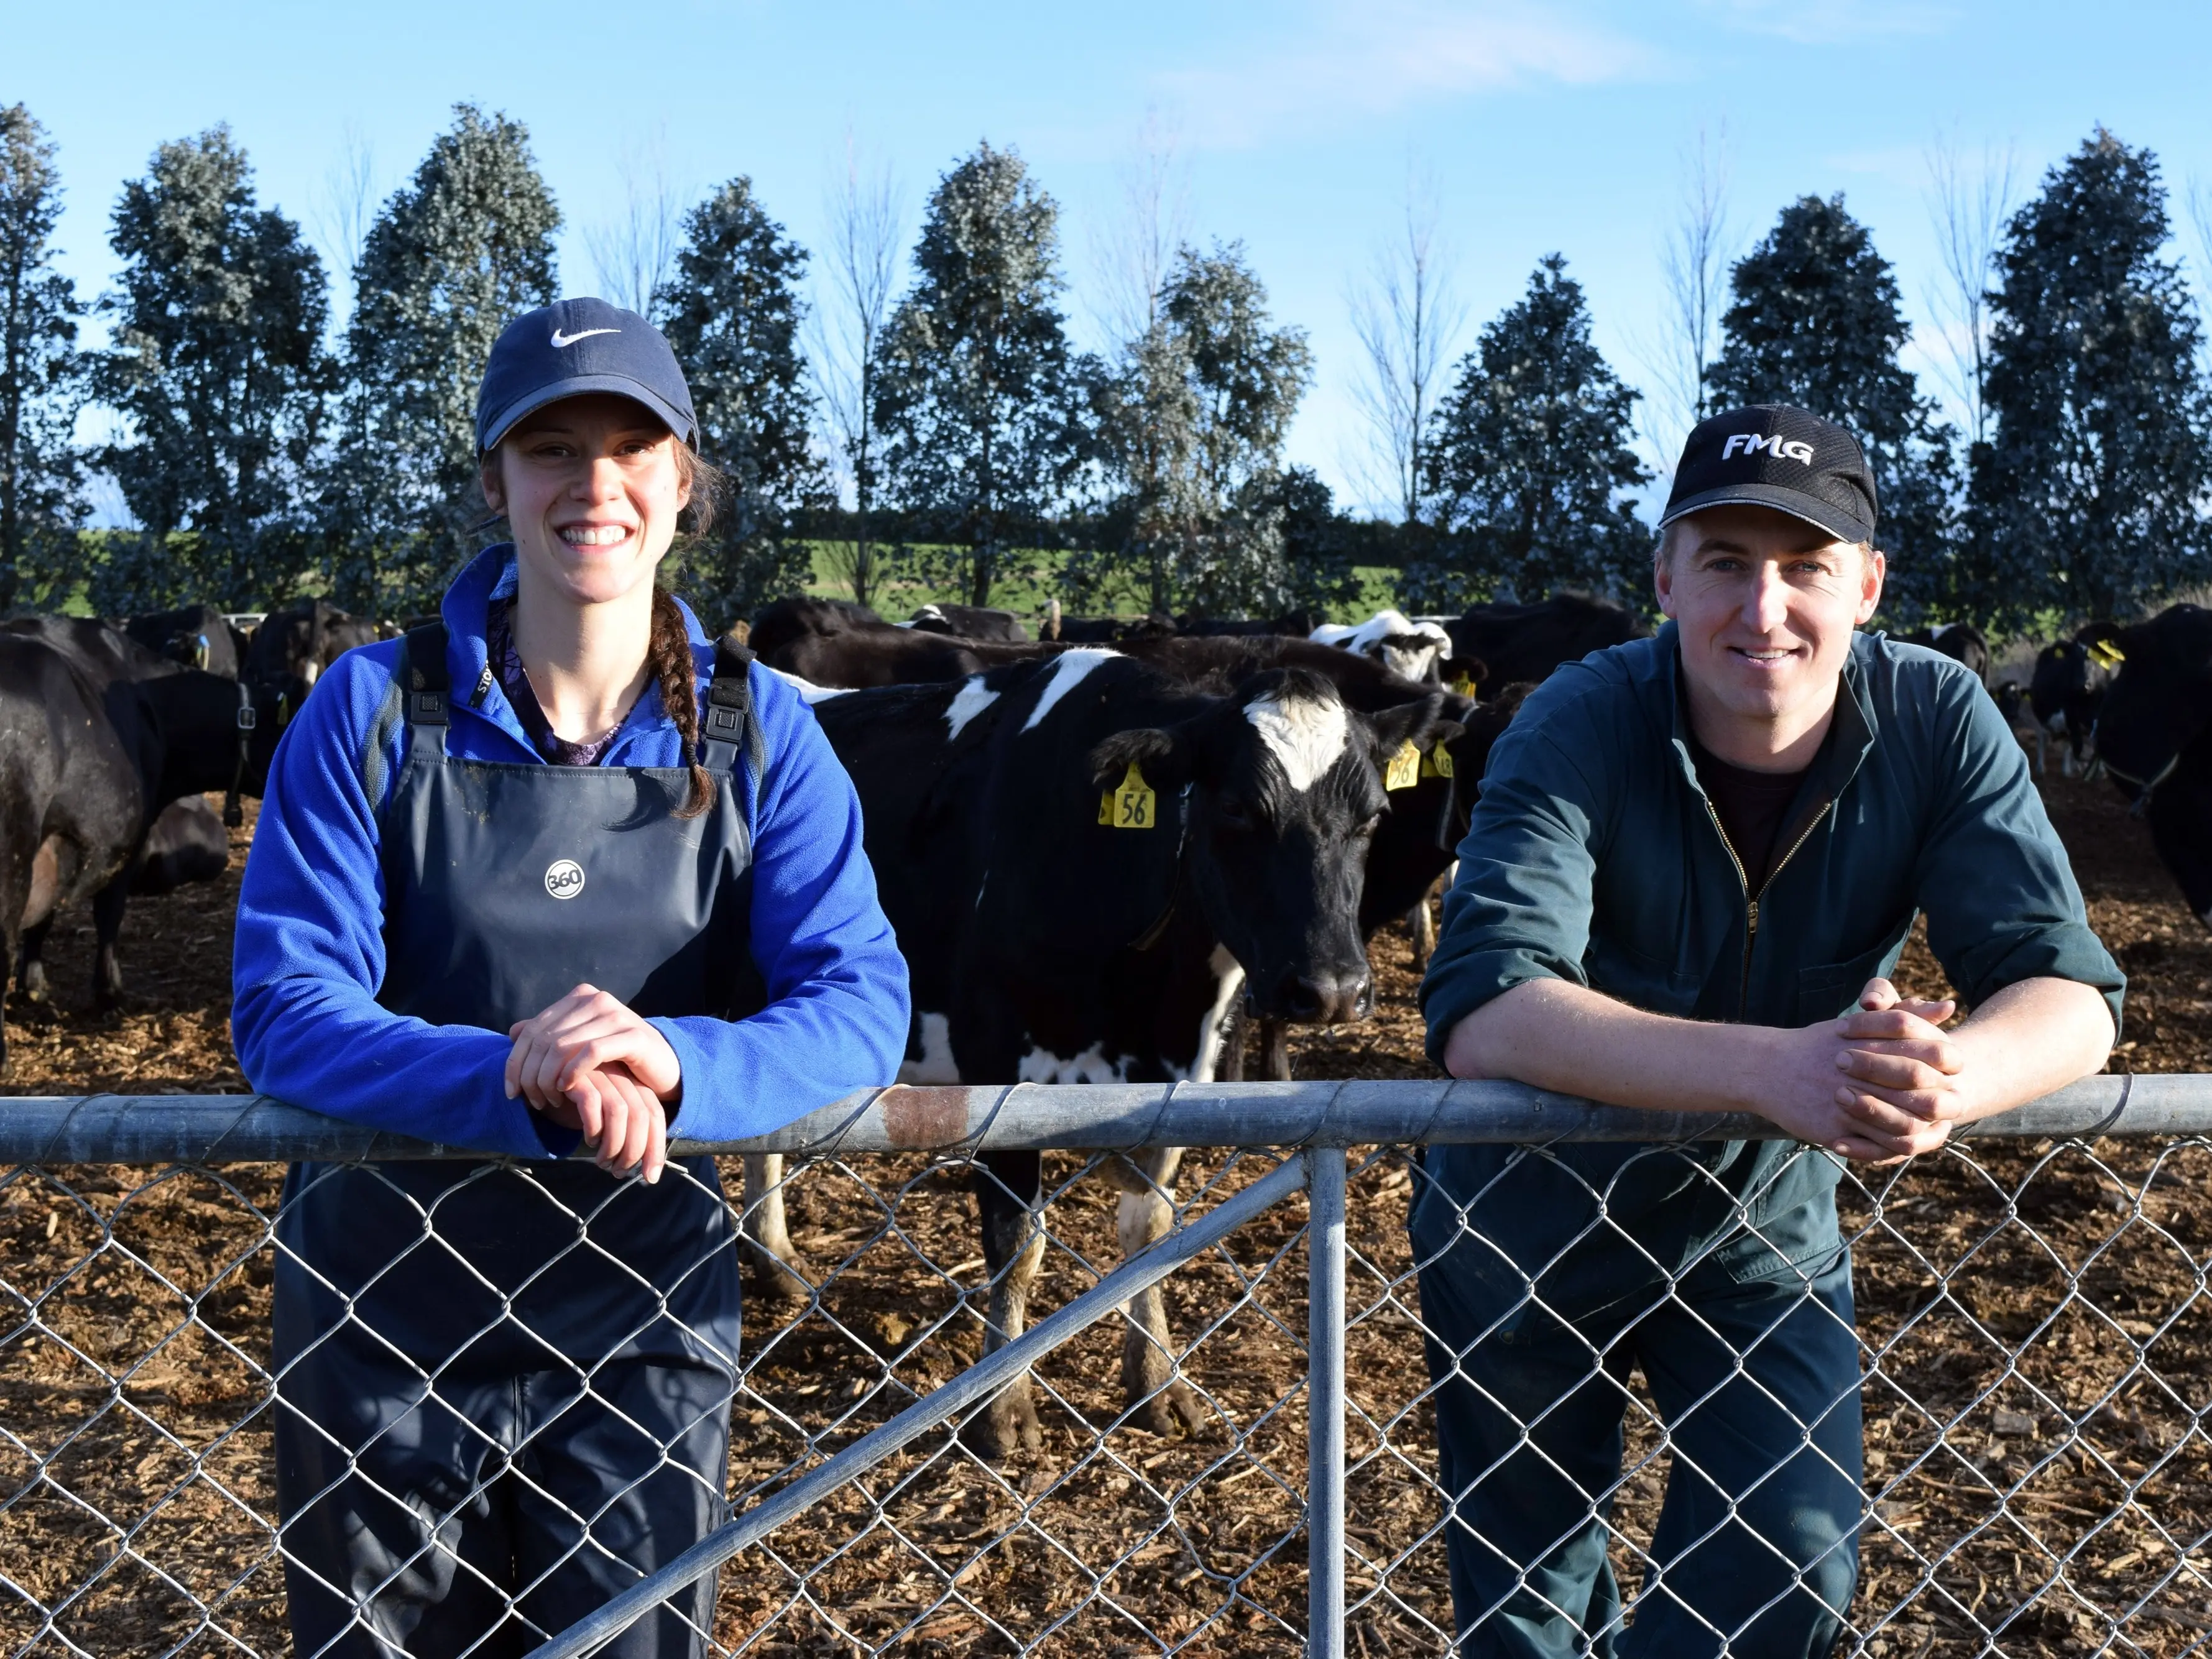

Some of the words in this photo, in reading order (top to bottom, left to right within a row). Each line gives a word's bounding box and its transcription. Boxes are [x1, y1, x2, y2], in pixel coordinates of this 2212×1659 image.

[1721, 433, 1814, 466] FMG
[1122, 793, 1146, 825] 56
[548, 869, 582, 890] 360
